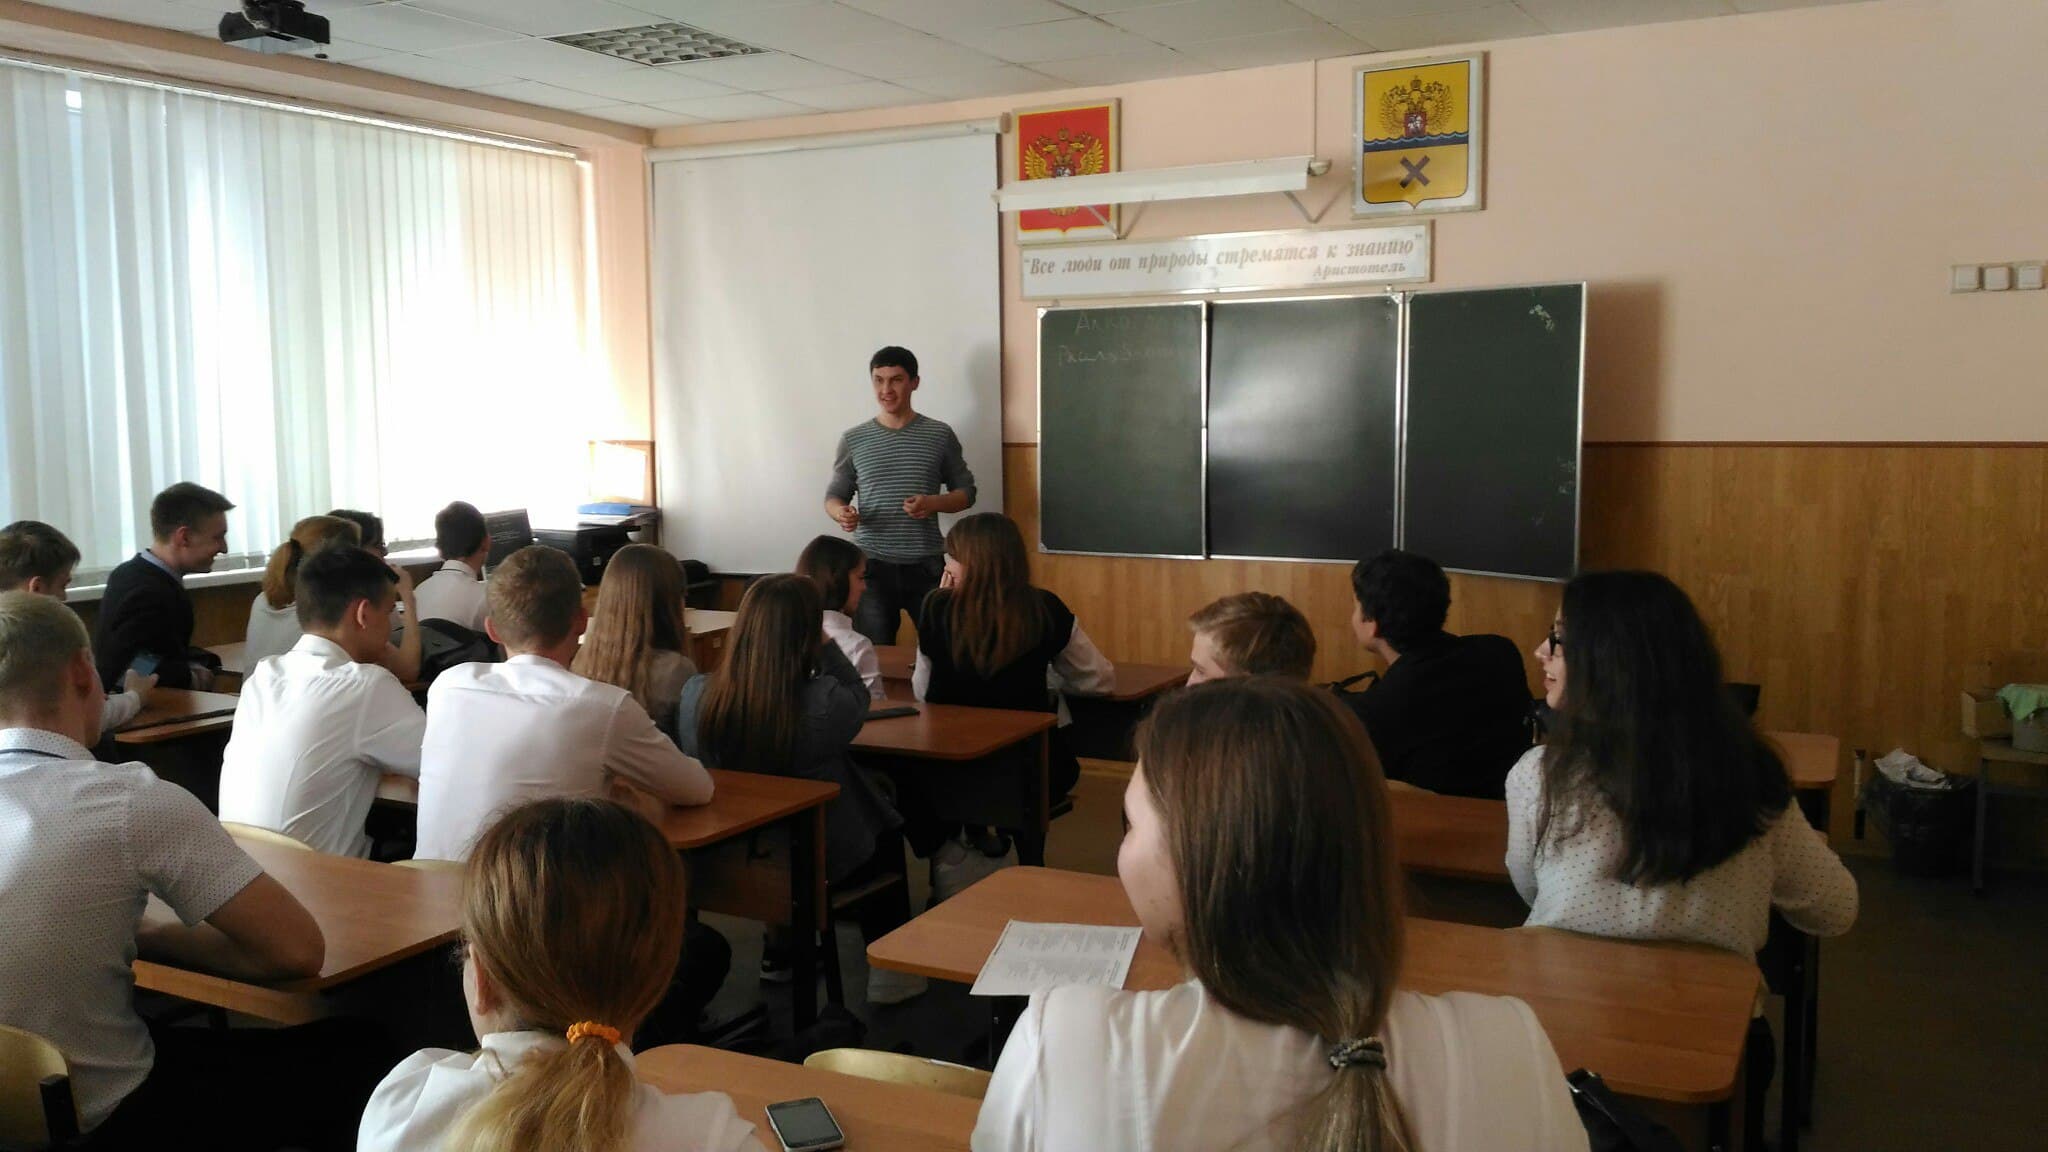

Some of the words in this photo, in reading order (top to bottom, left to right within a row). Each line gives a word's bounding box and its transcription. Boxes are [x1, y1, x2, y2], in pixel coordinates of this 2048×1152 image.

[1062, 255, 1101, 273] люди
[1109, 257, 1131, 271] от
[1138, 250, 1208, 273] природы
[1216, 245, 1318, 269] стремятся
[1326, 244, 1338, 258] к
[1313, 262, 1406, 279] Аристотель
